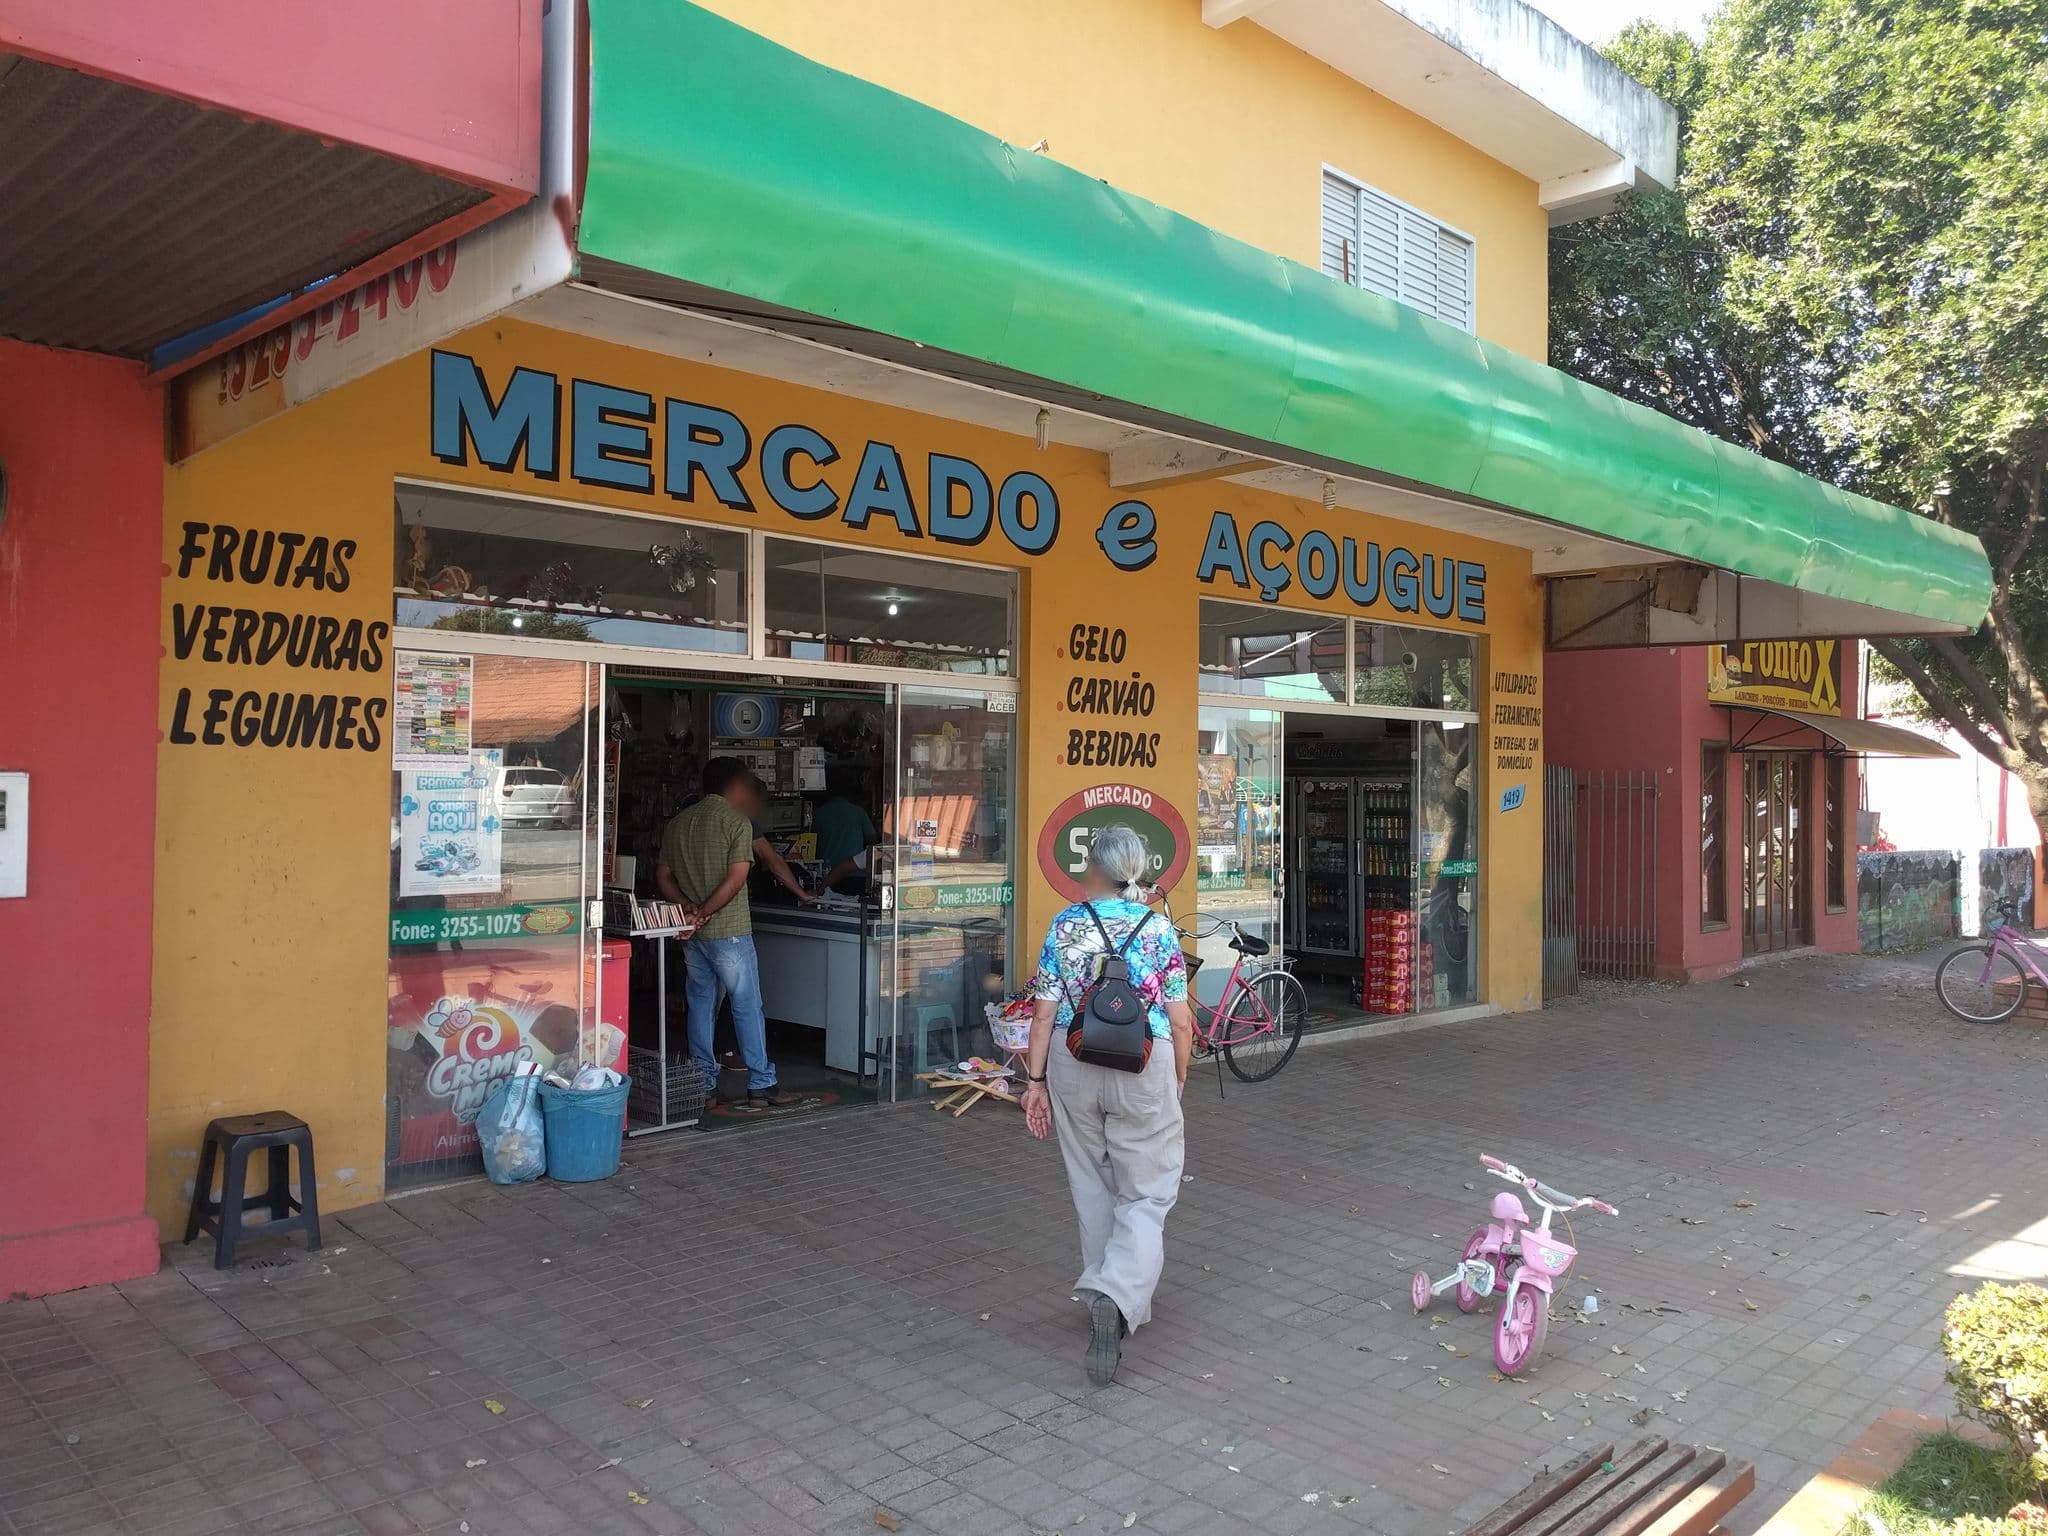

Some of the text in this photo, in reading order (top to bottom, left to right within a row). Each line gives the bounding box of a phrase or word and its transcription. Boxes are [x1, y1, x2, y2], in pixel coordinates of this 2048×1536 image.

[431, 348, 1487, 624] MERCADO e AÇOUGUE
[178, 521, 357, 593] FRUTAS
[172, 602, 389, 673] VERDURAS
[1069, 623, 1127, 664] GELO
[1066, 671, 1155, 717] CARVÃO
[1494, 671, 1538, 696] UTILIDADES
[990, 702, 1015, 712] ACEB
[1494, 704, 1541, 727] FERRAMENTAS
[169, 687, 388, 753] LEGUMES
[1067, 729, 1161, 769] BEBIDAS
[1494, 736, 1539, 751] ENTREGAS EM
[1497, 753, 1533, 770] DOMICÍLIO
[430, 802, 476, 812] COMPRE
[1083, 785, 1153, 809] MERCADO
[1503, 789, 1520, 806] 1419
[430, 812, 477, 833] AQUI
[937, 889, 962, 905] Fone:
[965, 886, 1013, 903] 3255-1075
[392, 919, 436, 940] Fone:
[440, 913, 521, 936] 3255-1075
[437, 1133, 482, 1149] Alime
